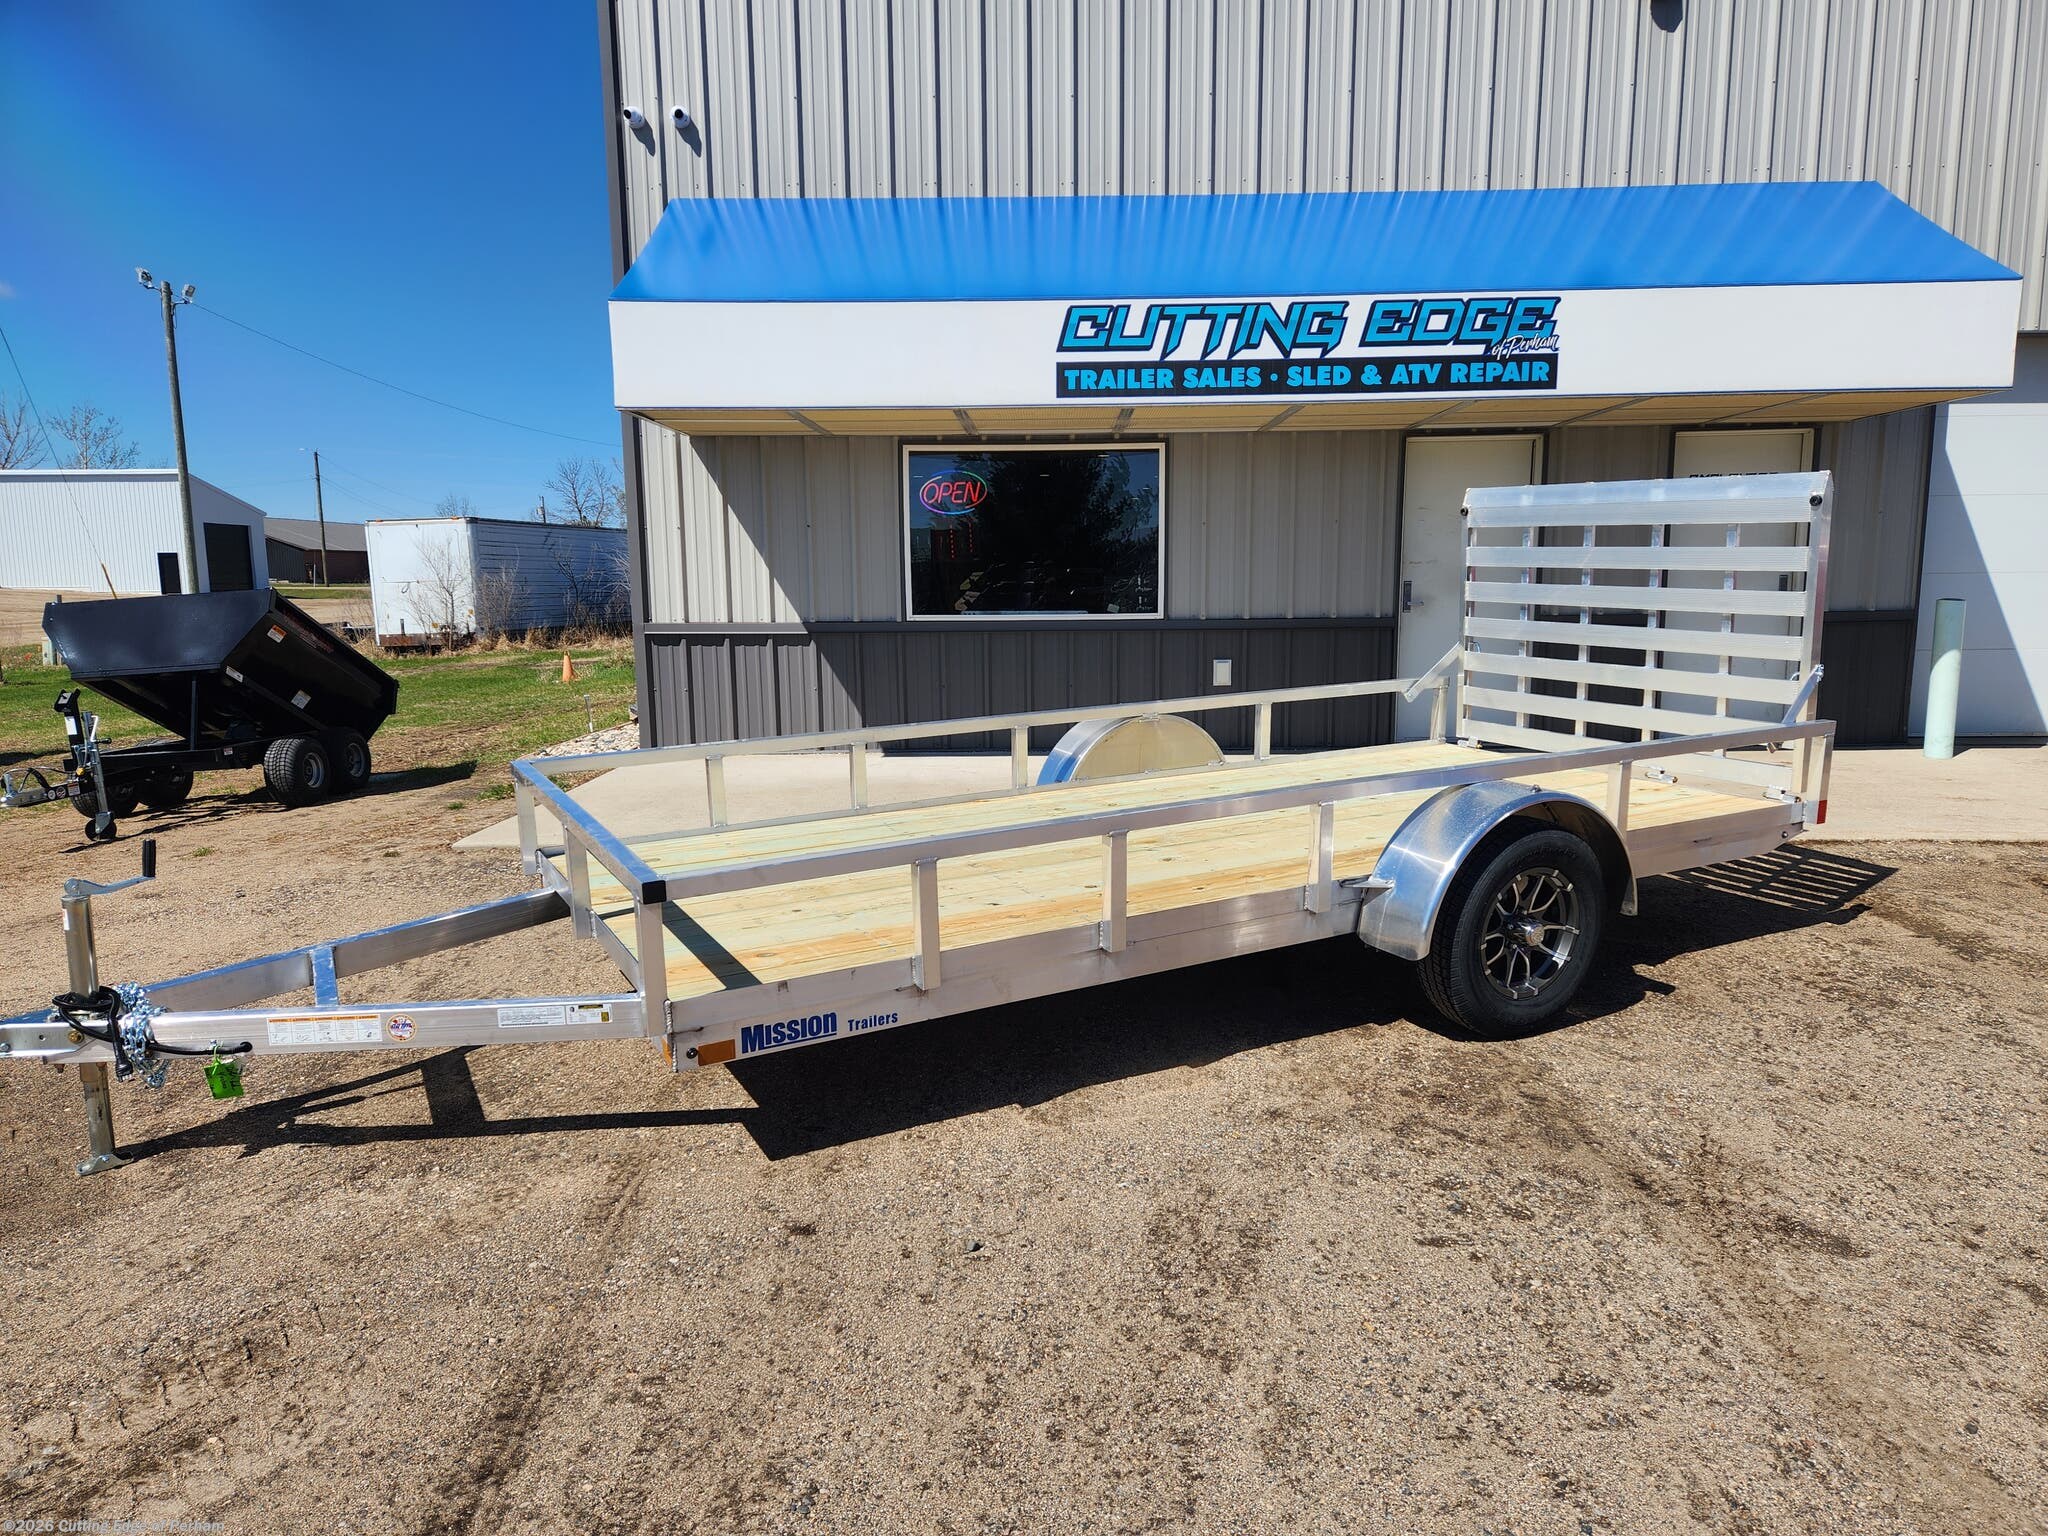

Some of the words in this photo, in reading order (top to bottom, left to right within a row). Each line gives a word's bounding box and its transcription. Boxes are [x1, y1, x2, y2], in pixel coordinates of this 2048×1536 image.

[1056, 301, 1349, 361] CUTTING
[1358, 297, 1561, 355] EDGE
[1491, 338, 1508, 360] of
[1505, 333, 1559, 359] Perham
[1064, 367, 1174, 390] TRAILER
[1183, 366, 1261, 389] SALES
[1286, 365, 1352, 387] SLED
[1360, 364, 1382, 385] &
[1390, 363, 1442, 385] ATV
[1450, 361, 1550, 384] REPAIR
[923, 481, 981, 504] OPEN
[848, 1012, 899, 1031] Trailers
